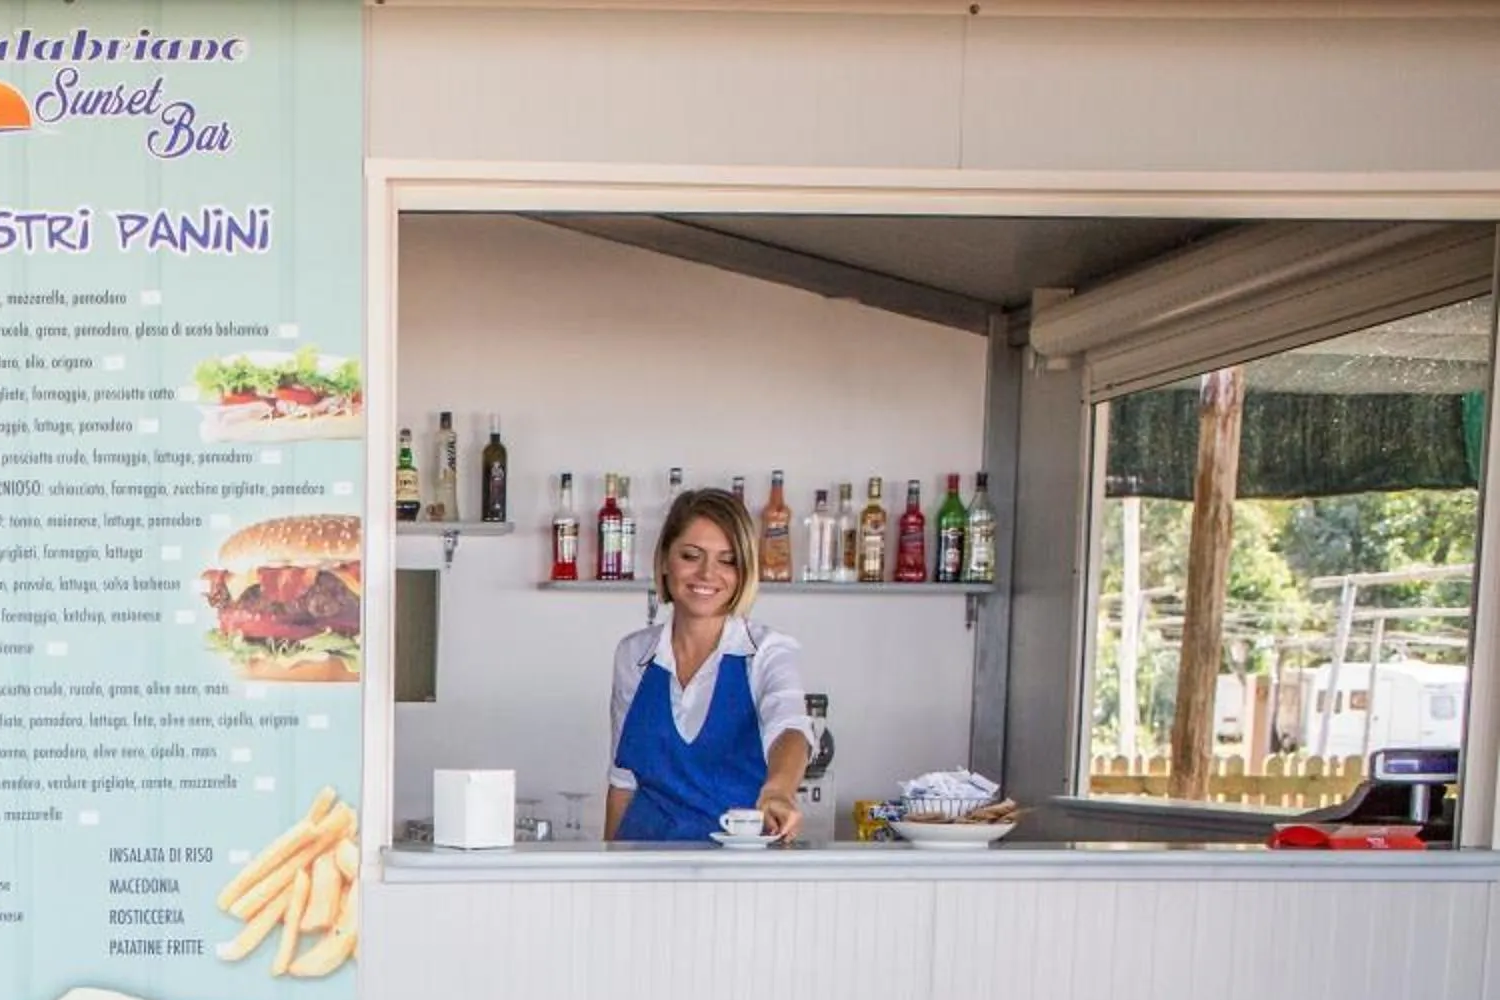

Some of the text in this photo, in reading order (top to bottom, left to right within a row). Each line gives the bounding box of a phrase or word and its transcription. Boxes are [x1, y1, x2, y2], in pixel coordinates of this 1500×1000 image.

[35, 67, 164, 123] Sunset
[147, 102, 235, 158] Bar
[109, 847, 213, 863] INSALATA DI RISO
[110, 877, 180, 895] MACEDONIA
[109, 908, 184, 925] ROSTICCERIA
[109, 939, 204, 956] PATATINE FRITTE
